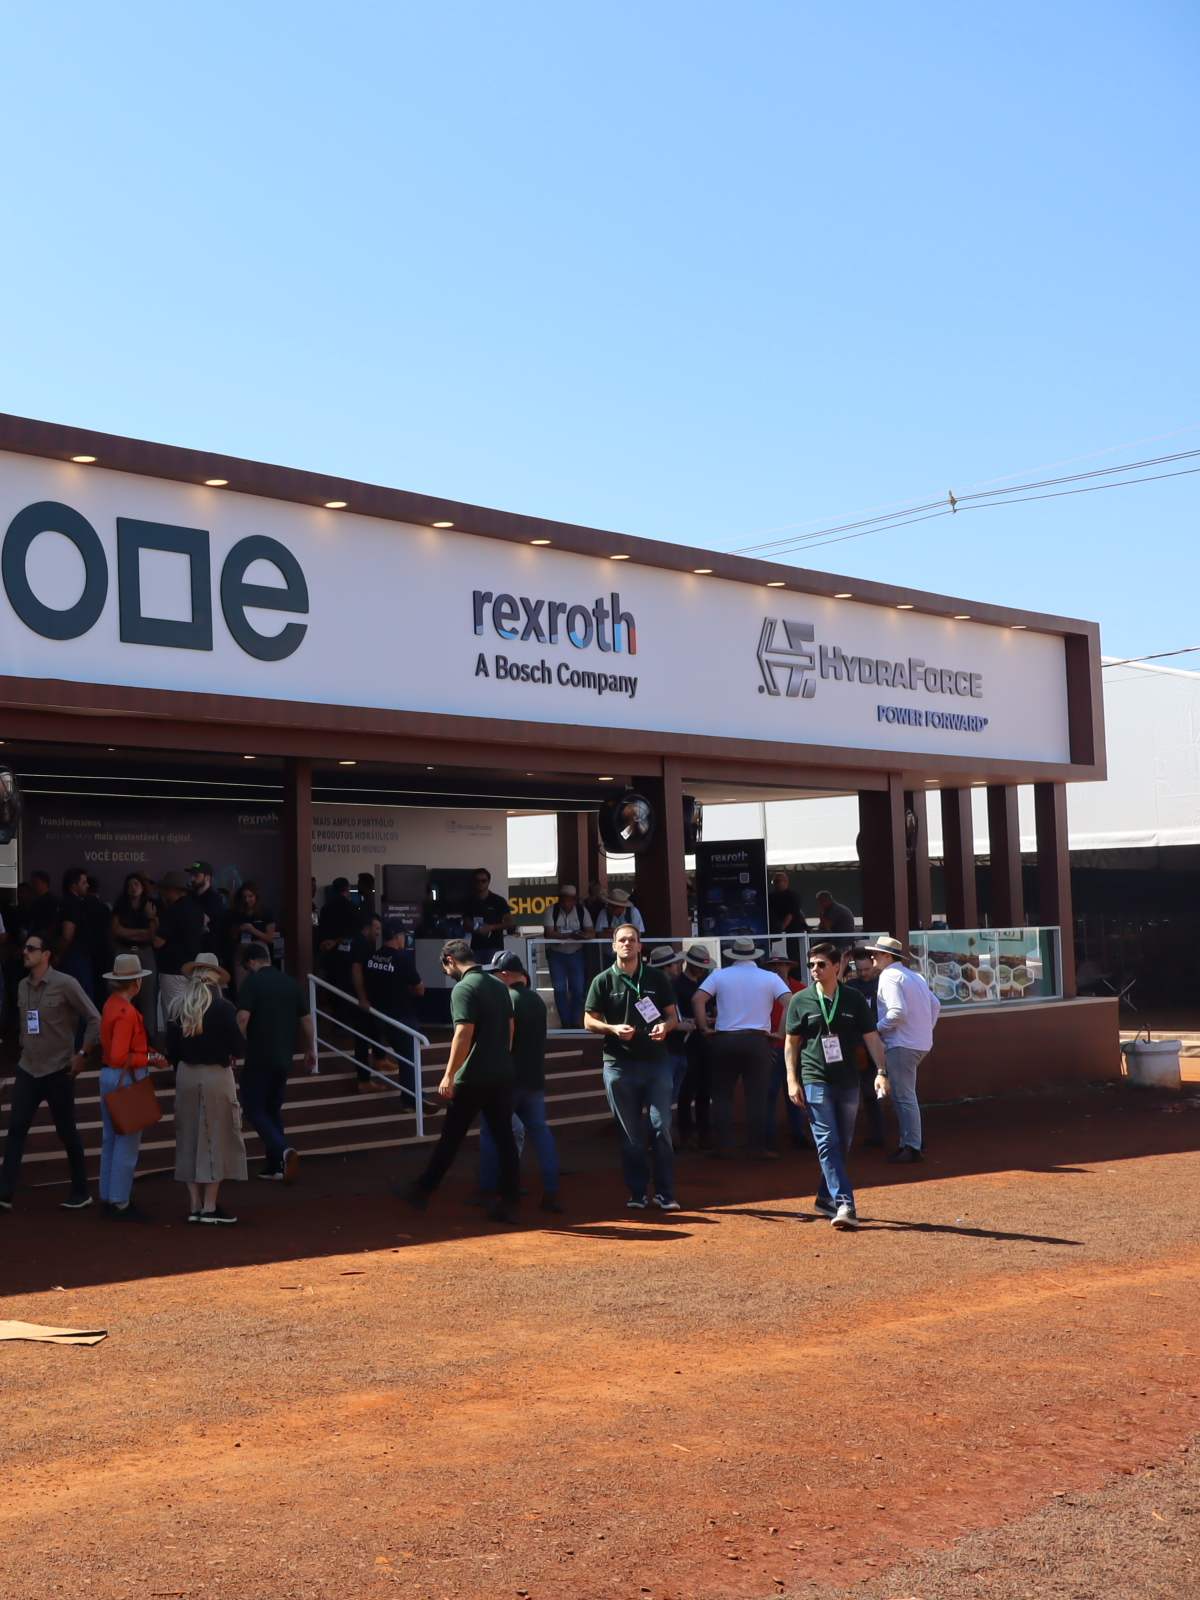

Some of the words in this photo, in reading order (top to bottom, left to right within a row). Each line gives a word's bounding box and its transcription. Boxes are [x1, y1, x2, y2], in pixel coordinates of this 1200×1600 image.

[472, 590, 637, 655] rexroth
[475, 653, 490, 677] A
[495, 654, 552, 685] Bosch
[557, 662, 638, 698] Company
[877, 705, 923, 727] POWER
[39, 816, 102, 828] Transformamos
[313, 817, 331, 826] MAIS
[332, 818, 356, 827] AMPLO
[94, 831, 113, 841] mais
[115, 832, 159, 842] sustentável
[317, 831, 353, 840] PRODUTOS
[311, 844, 350, 853] OMPACTOS
[351, 845, 360, 853] DO
[362, 845, 387, 854] MUNDO
[84, 849, 110, 862] VOCÊ
[111, 852, 149, 862] DECIDE.
[711, 850, 750, 862] rexroth
[367, 960, 395, 973] Bosch
